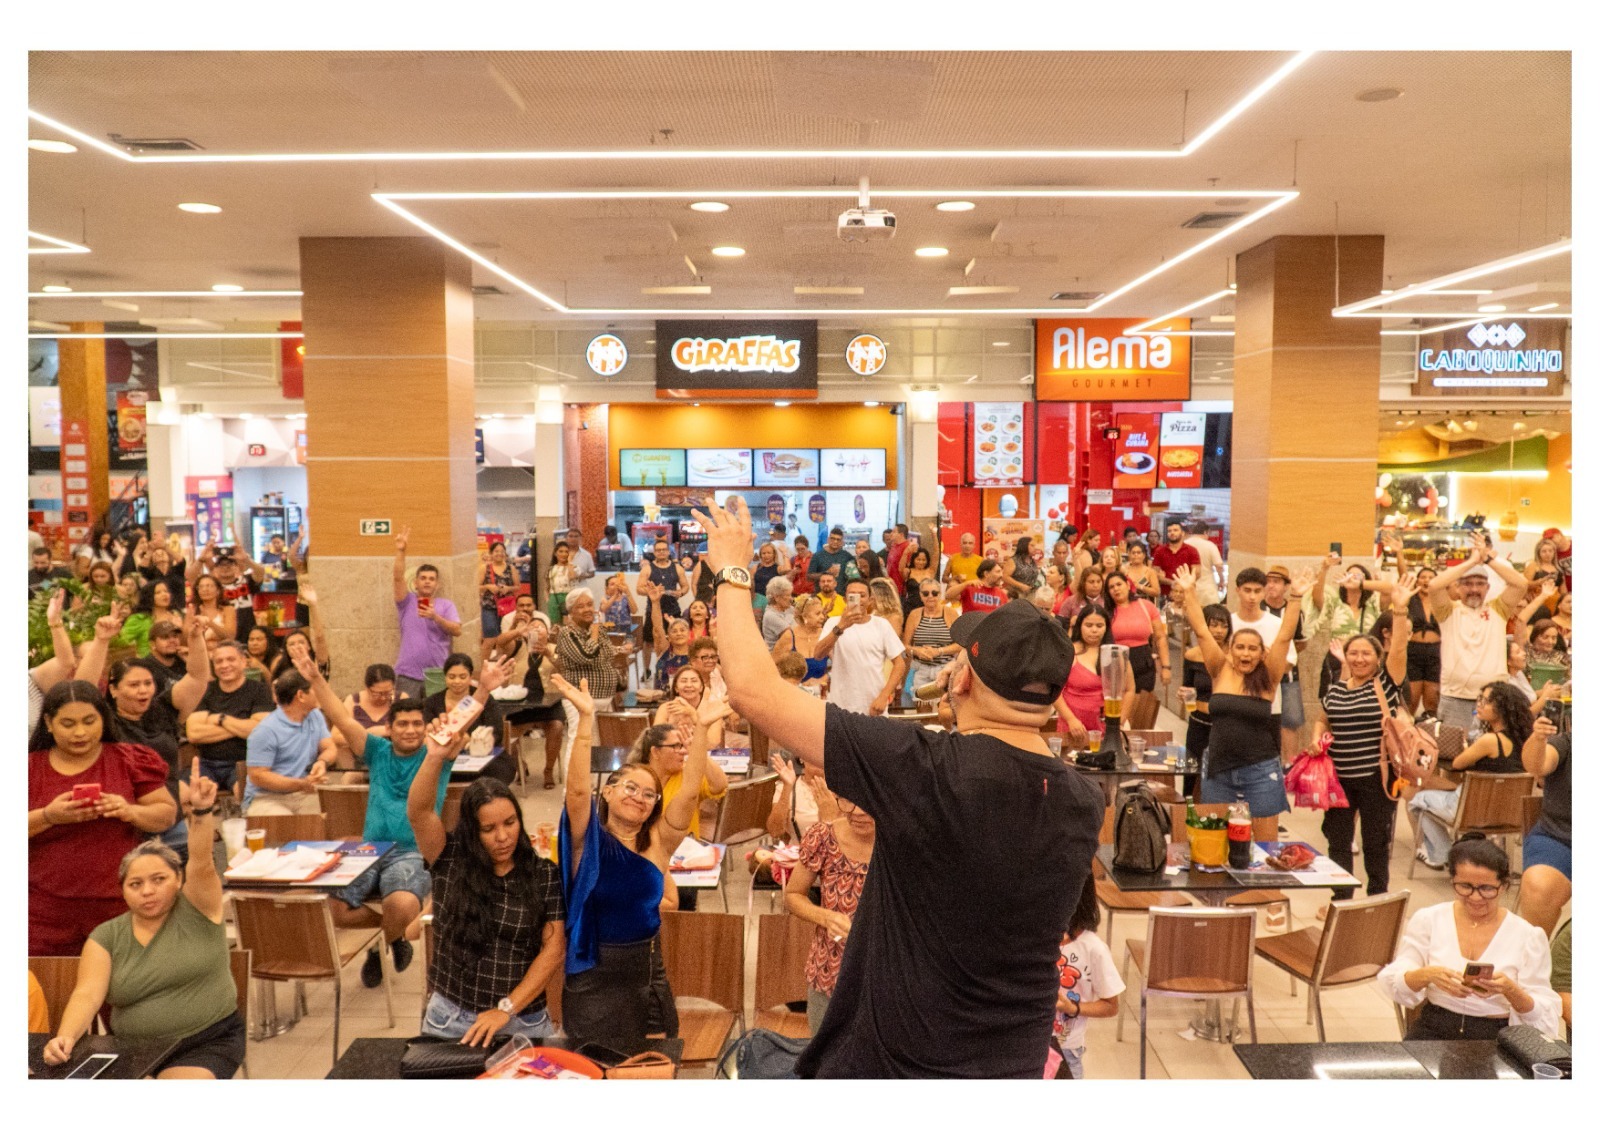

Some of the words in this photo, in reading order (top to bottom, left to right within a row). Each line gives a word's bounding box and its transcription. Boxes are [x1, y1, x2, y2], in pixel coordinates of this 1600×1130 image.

[1420, 349, 1562, 374] CABOQUINHO
[1072, 378, 1152, 388] GOURMET
[1169, 423, 1197, 433] Pizza
[973, 593, 1001, 605] 1997
